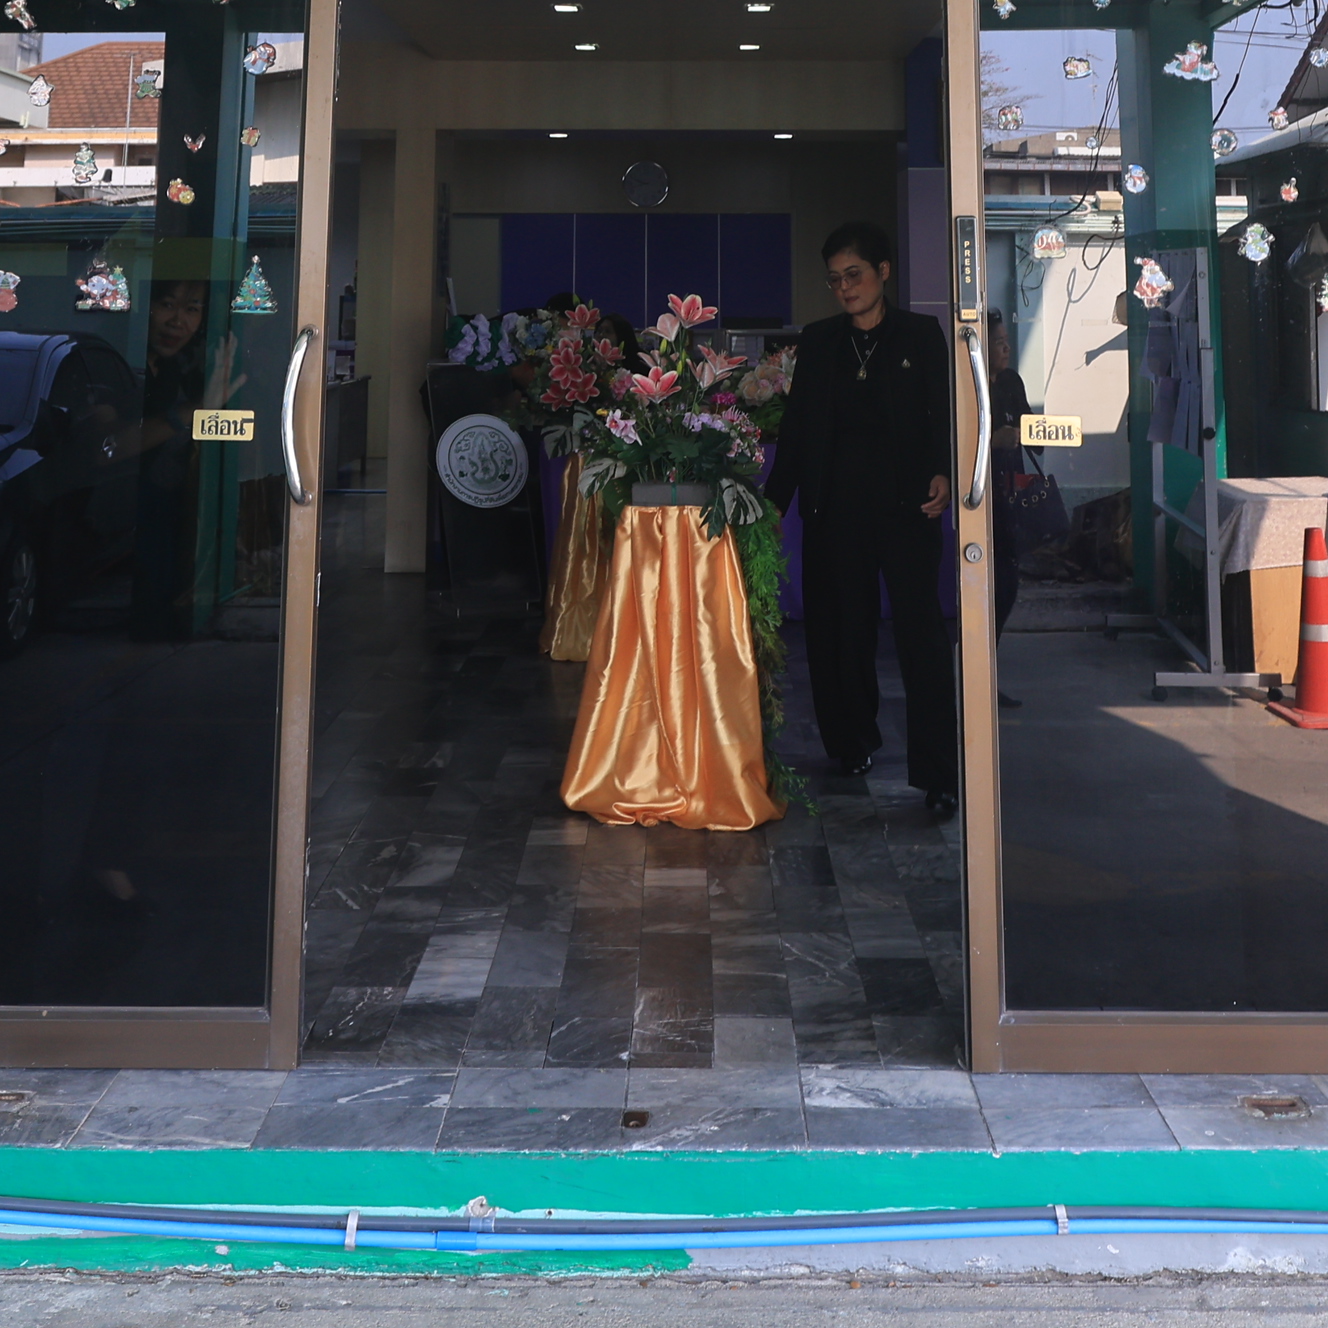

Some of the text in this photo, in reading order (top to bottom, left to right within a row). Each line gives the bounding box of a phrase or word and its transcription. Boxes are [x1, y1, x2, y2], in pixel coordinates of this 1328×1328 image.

[964, 240, 972, 284] PRESS
[200, 413, 247, 436] เลื่อน
[1028, 417, 1075, 441] เลื่อน
